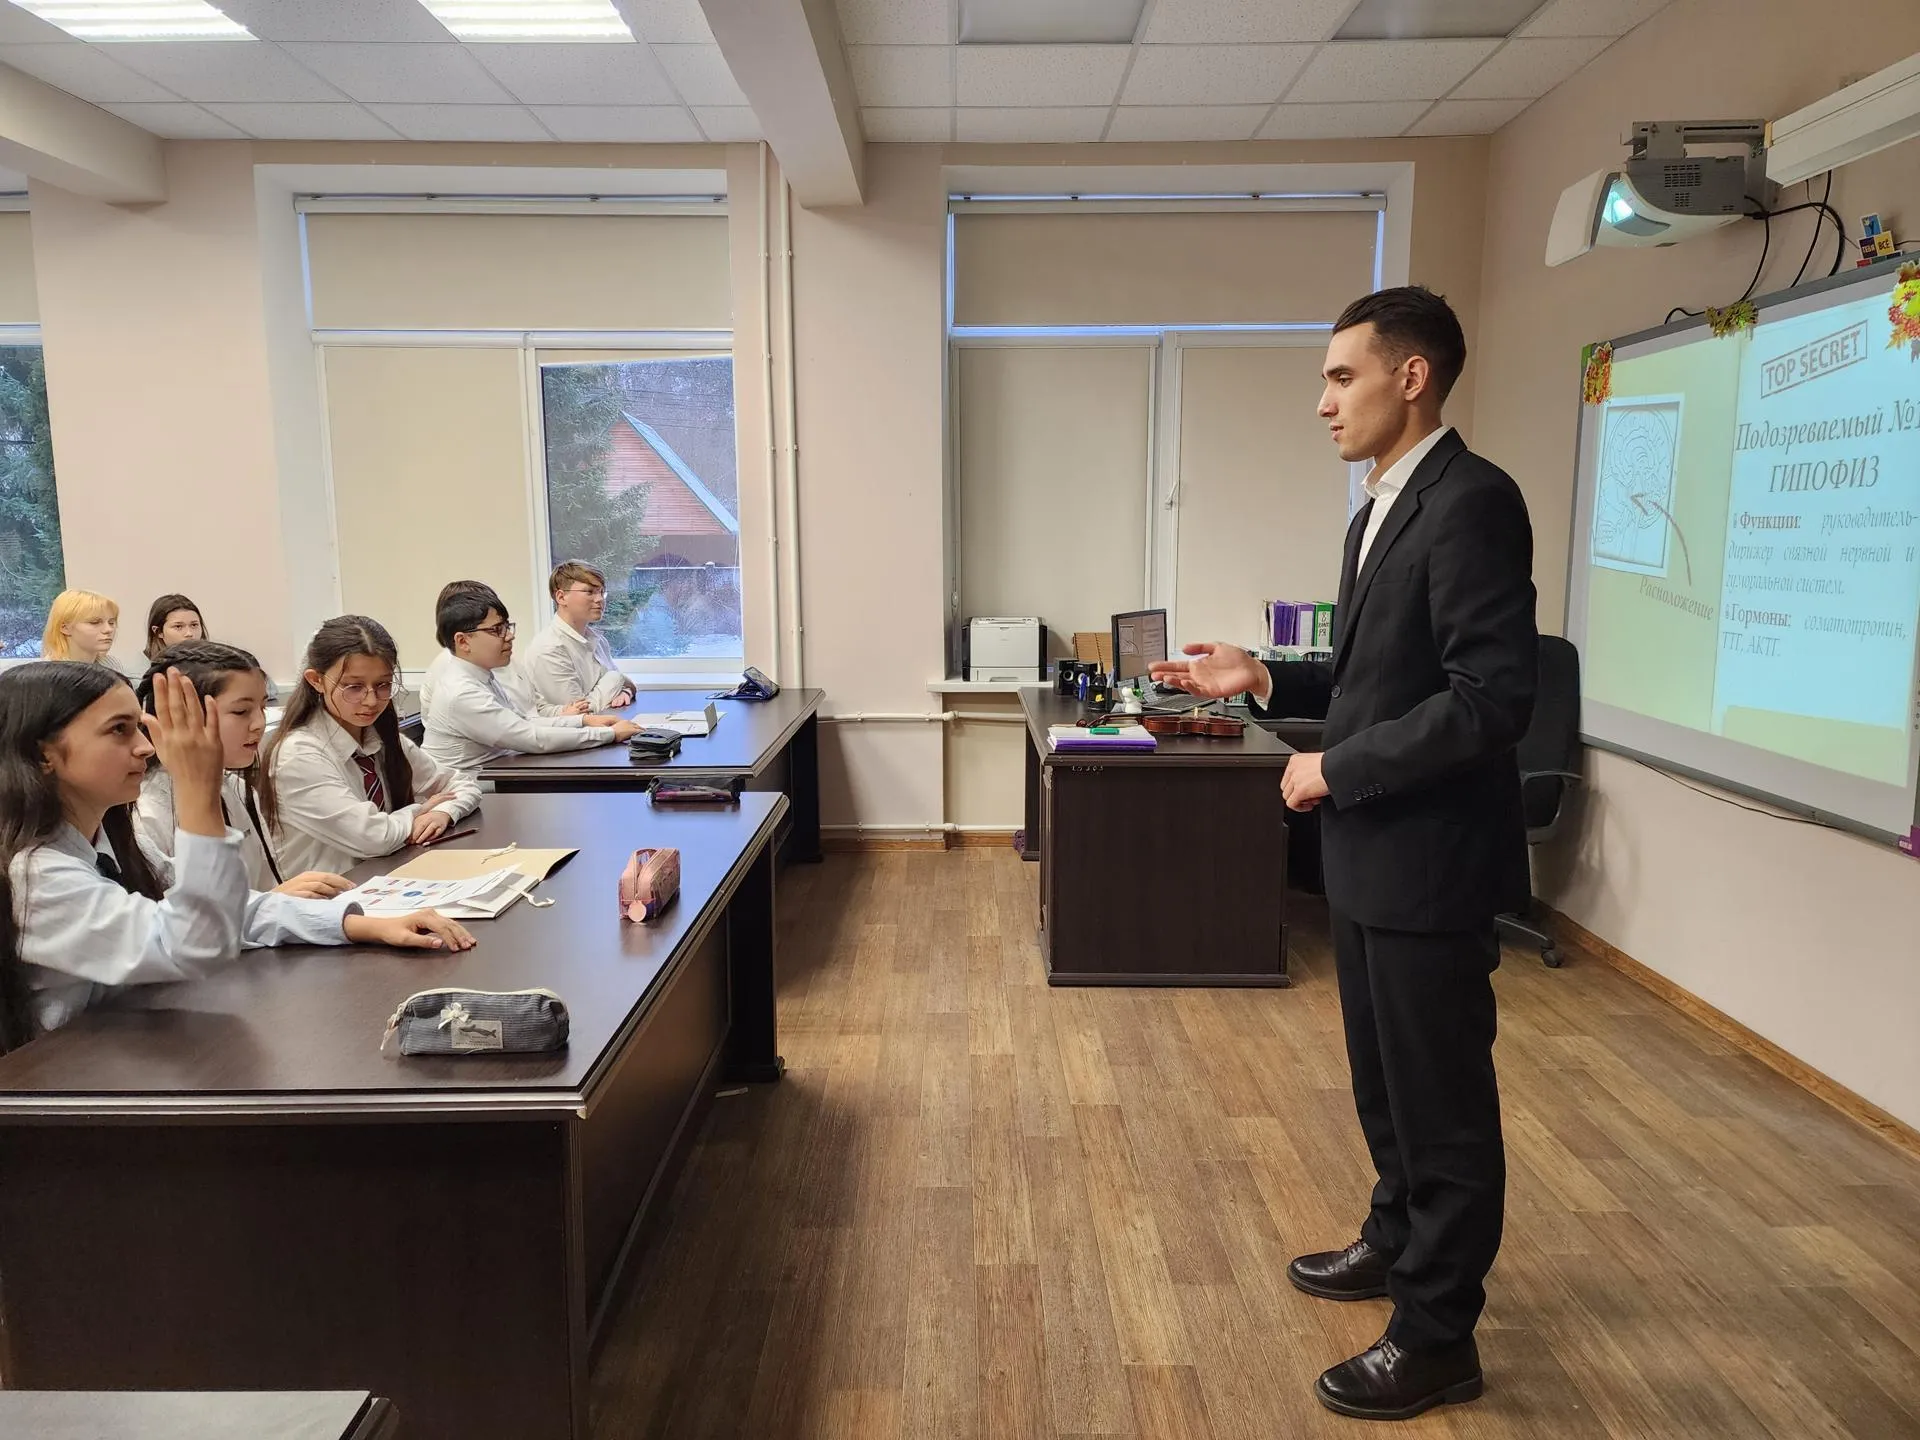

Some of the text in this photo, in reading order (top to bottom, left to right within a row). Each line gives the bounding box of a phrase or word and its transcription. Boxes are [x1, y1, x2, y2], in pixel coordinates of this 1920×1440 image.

[1766, 330, 1861, 390] TOP SECRET
[1735, 407, 1884, 455] Подозреваемый
[1768, 456, 1880, 493] ГИПОФИЗ
[1740, 506, 1920, 536] Функции: руководитель-
[1905, 545, 1915, 562] и
[1639, 575, 1714, 620] Расположение
[1731, 603, 1909, 641] Гормоны: соматотропин,
